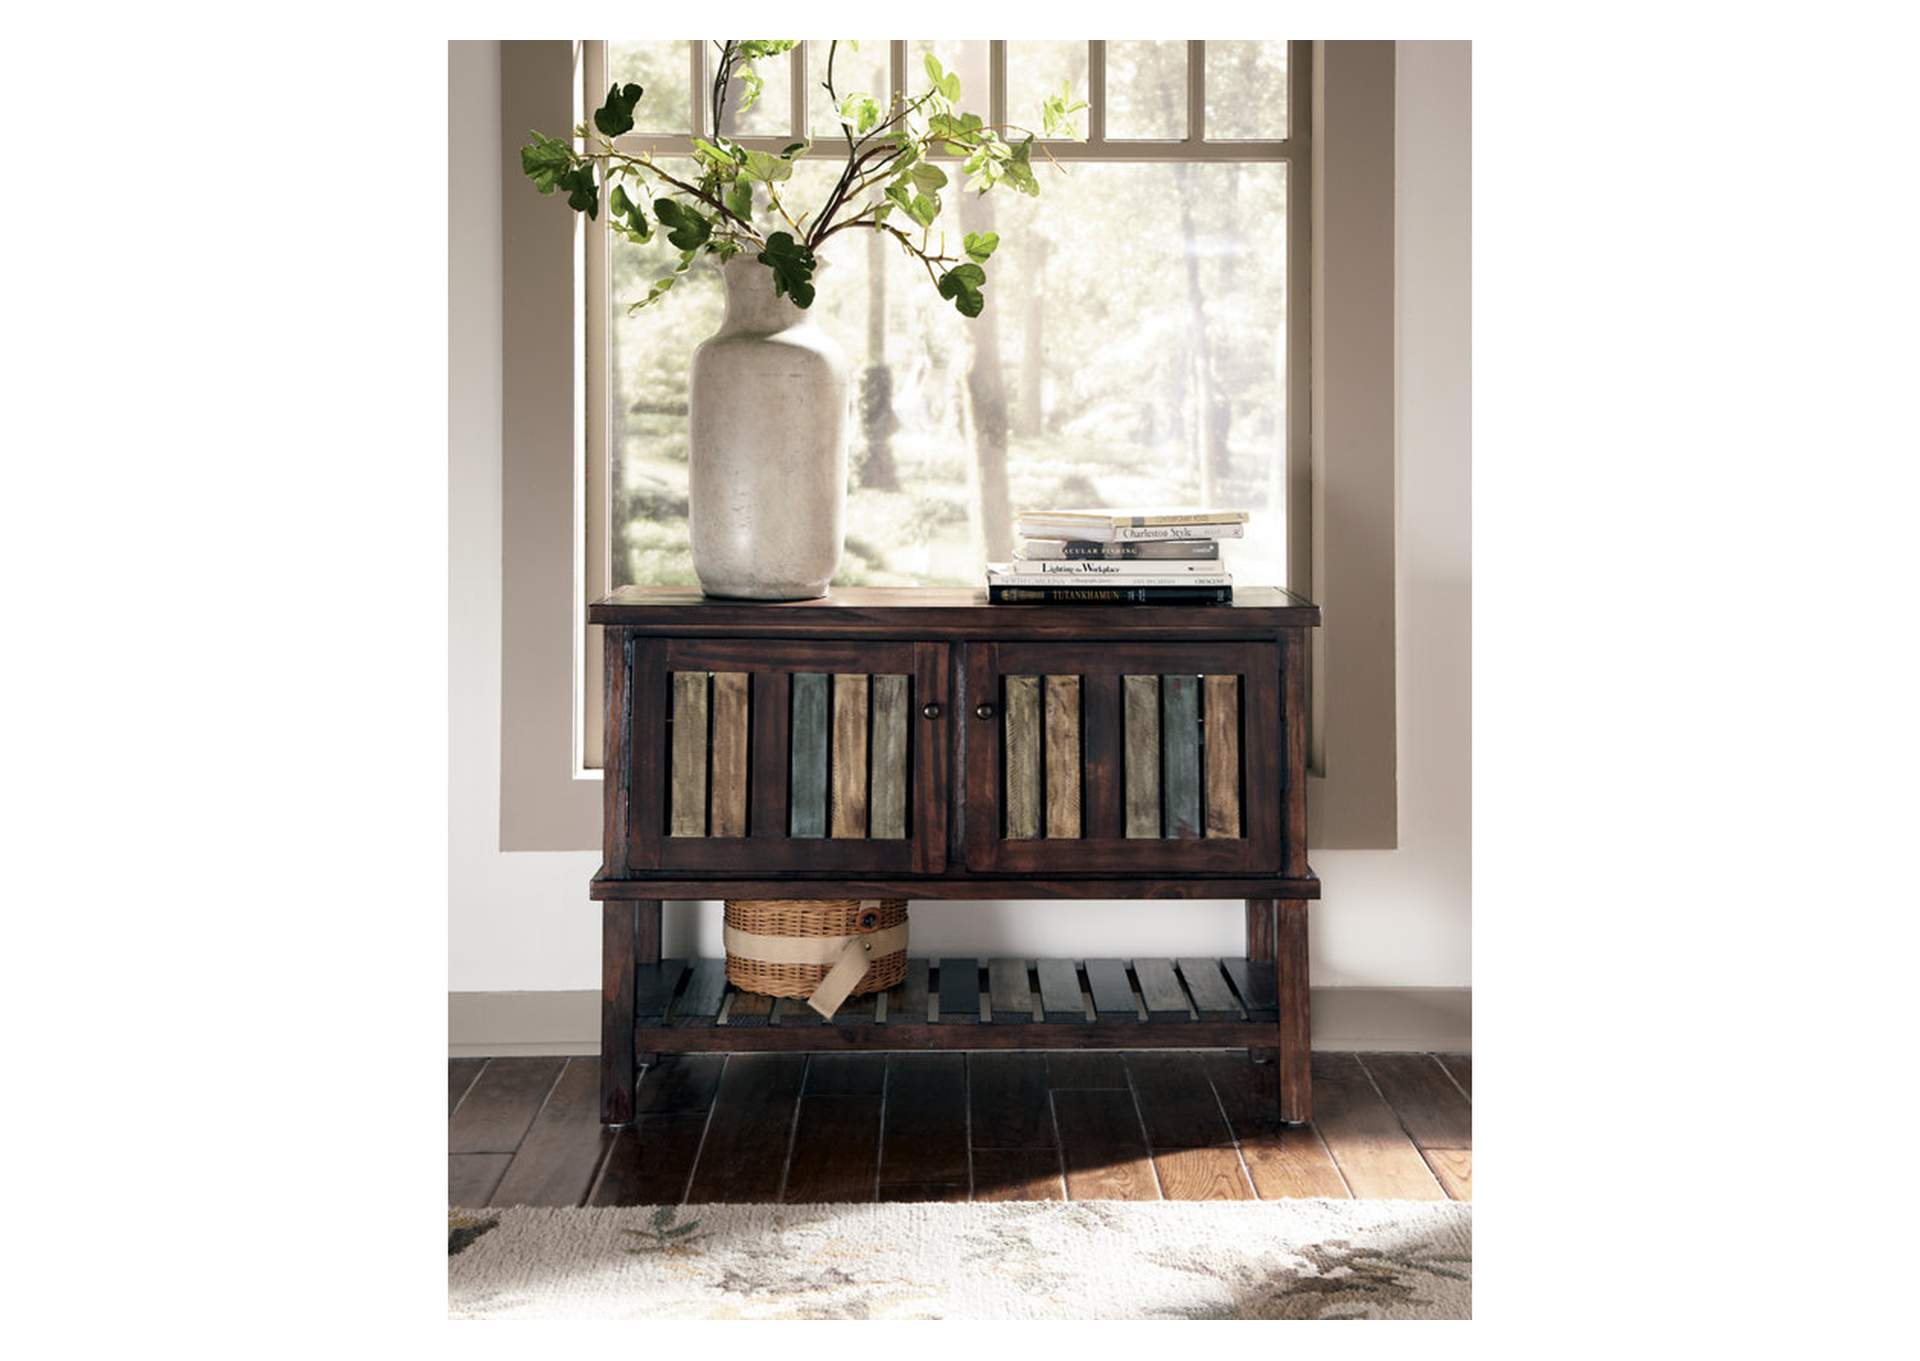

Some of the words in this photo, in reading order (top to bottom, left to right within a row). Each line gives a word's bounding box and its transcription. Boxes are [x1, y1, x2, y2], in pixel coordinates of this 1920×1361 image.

[1123, 527, 1168, 539] Charleston
[1170, 525, 1192, 540] Style
[1053, 590, 1120, 601] TUTANKHAMUN
